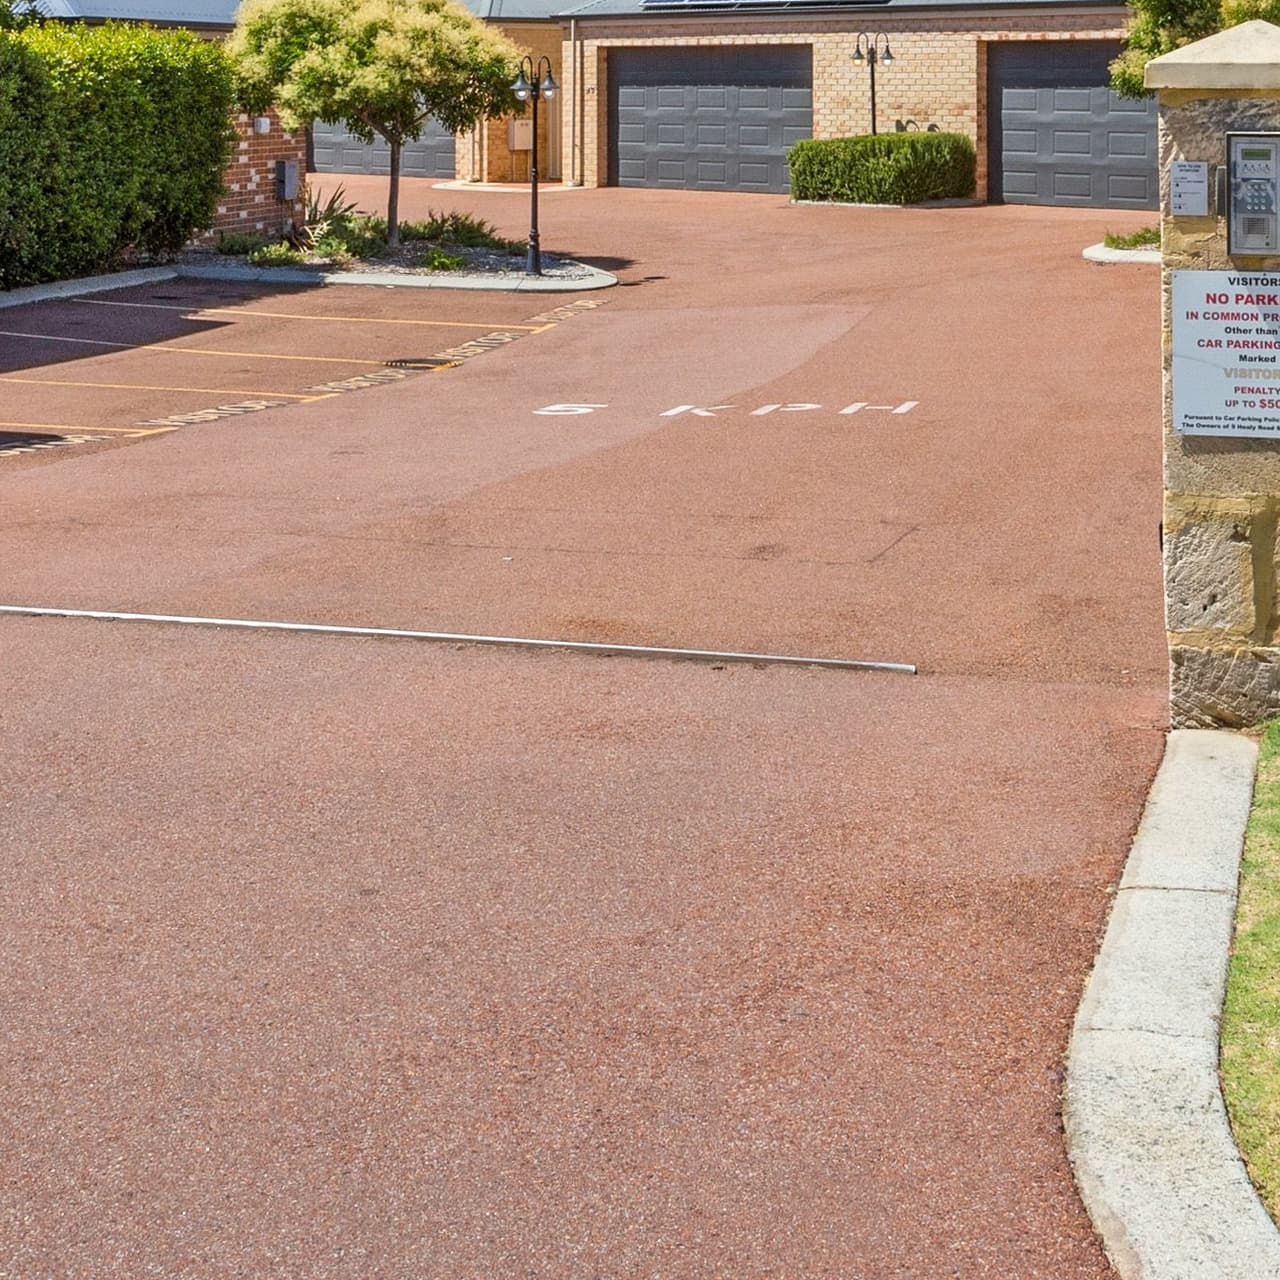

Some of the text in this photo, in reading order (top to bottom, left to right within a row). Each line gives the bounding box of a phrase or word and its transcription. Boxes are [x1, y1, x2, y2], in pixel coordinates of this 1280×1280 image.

[1206, 293, 1229, 304] NO
[1186, 311, 1199, 320] IN
[1202, 312, 1259, 321] COMMON
[1224, 326, 1252, 335] Other
[1255, 327, 1278, 335] than
[1197, 339, 1223, 348] CAR
[1238, 354, 1276, 363] Marked
[1224, 400, 1239, 408] UP
[1242, 400, 1256, 408] TO
[658, 401, 920, 417] KPH
